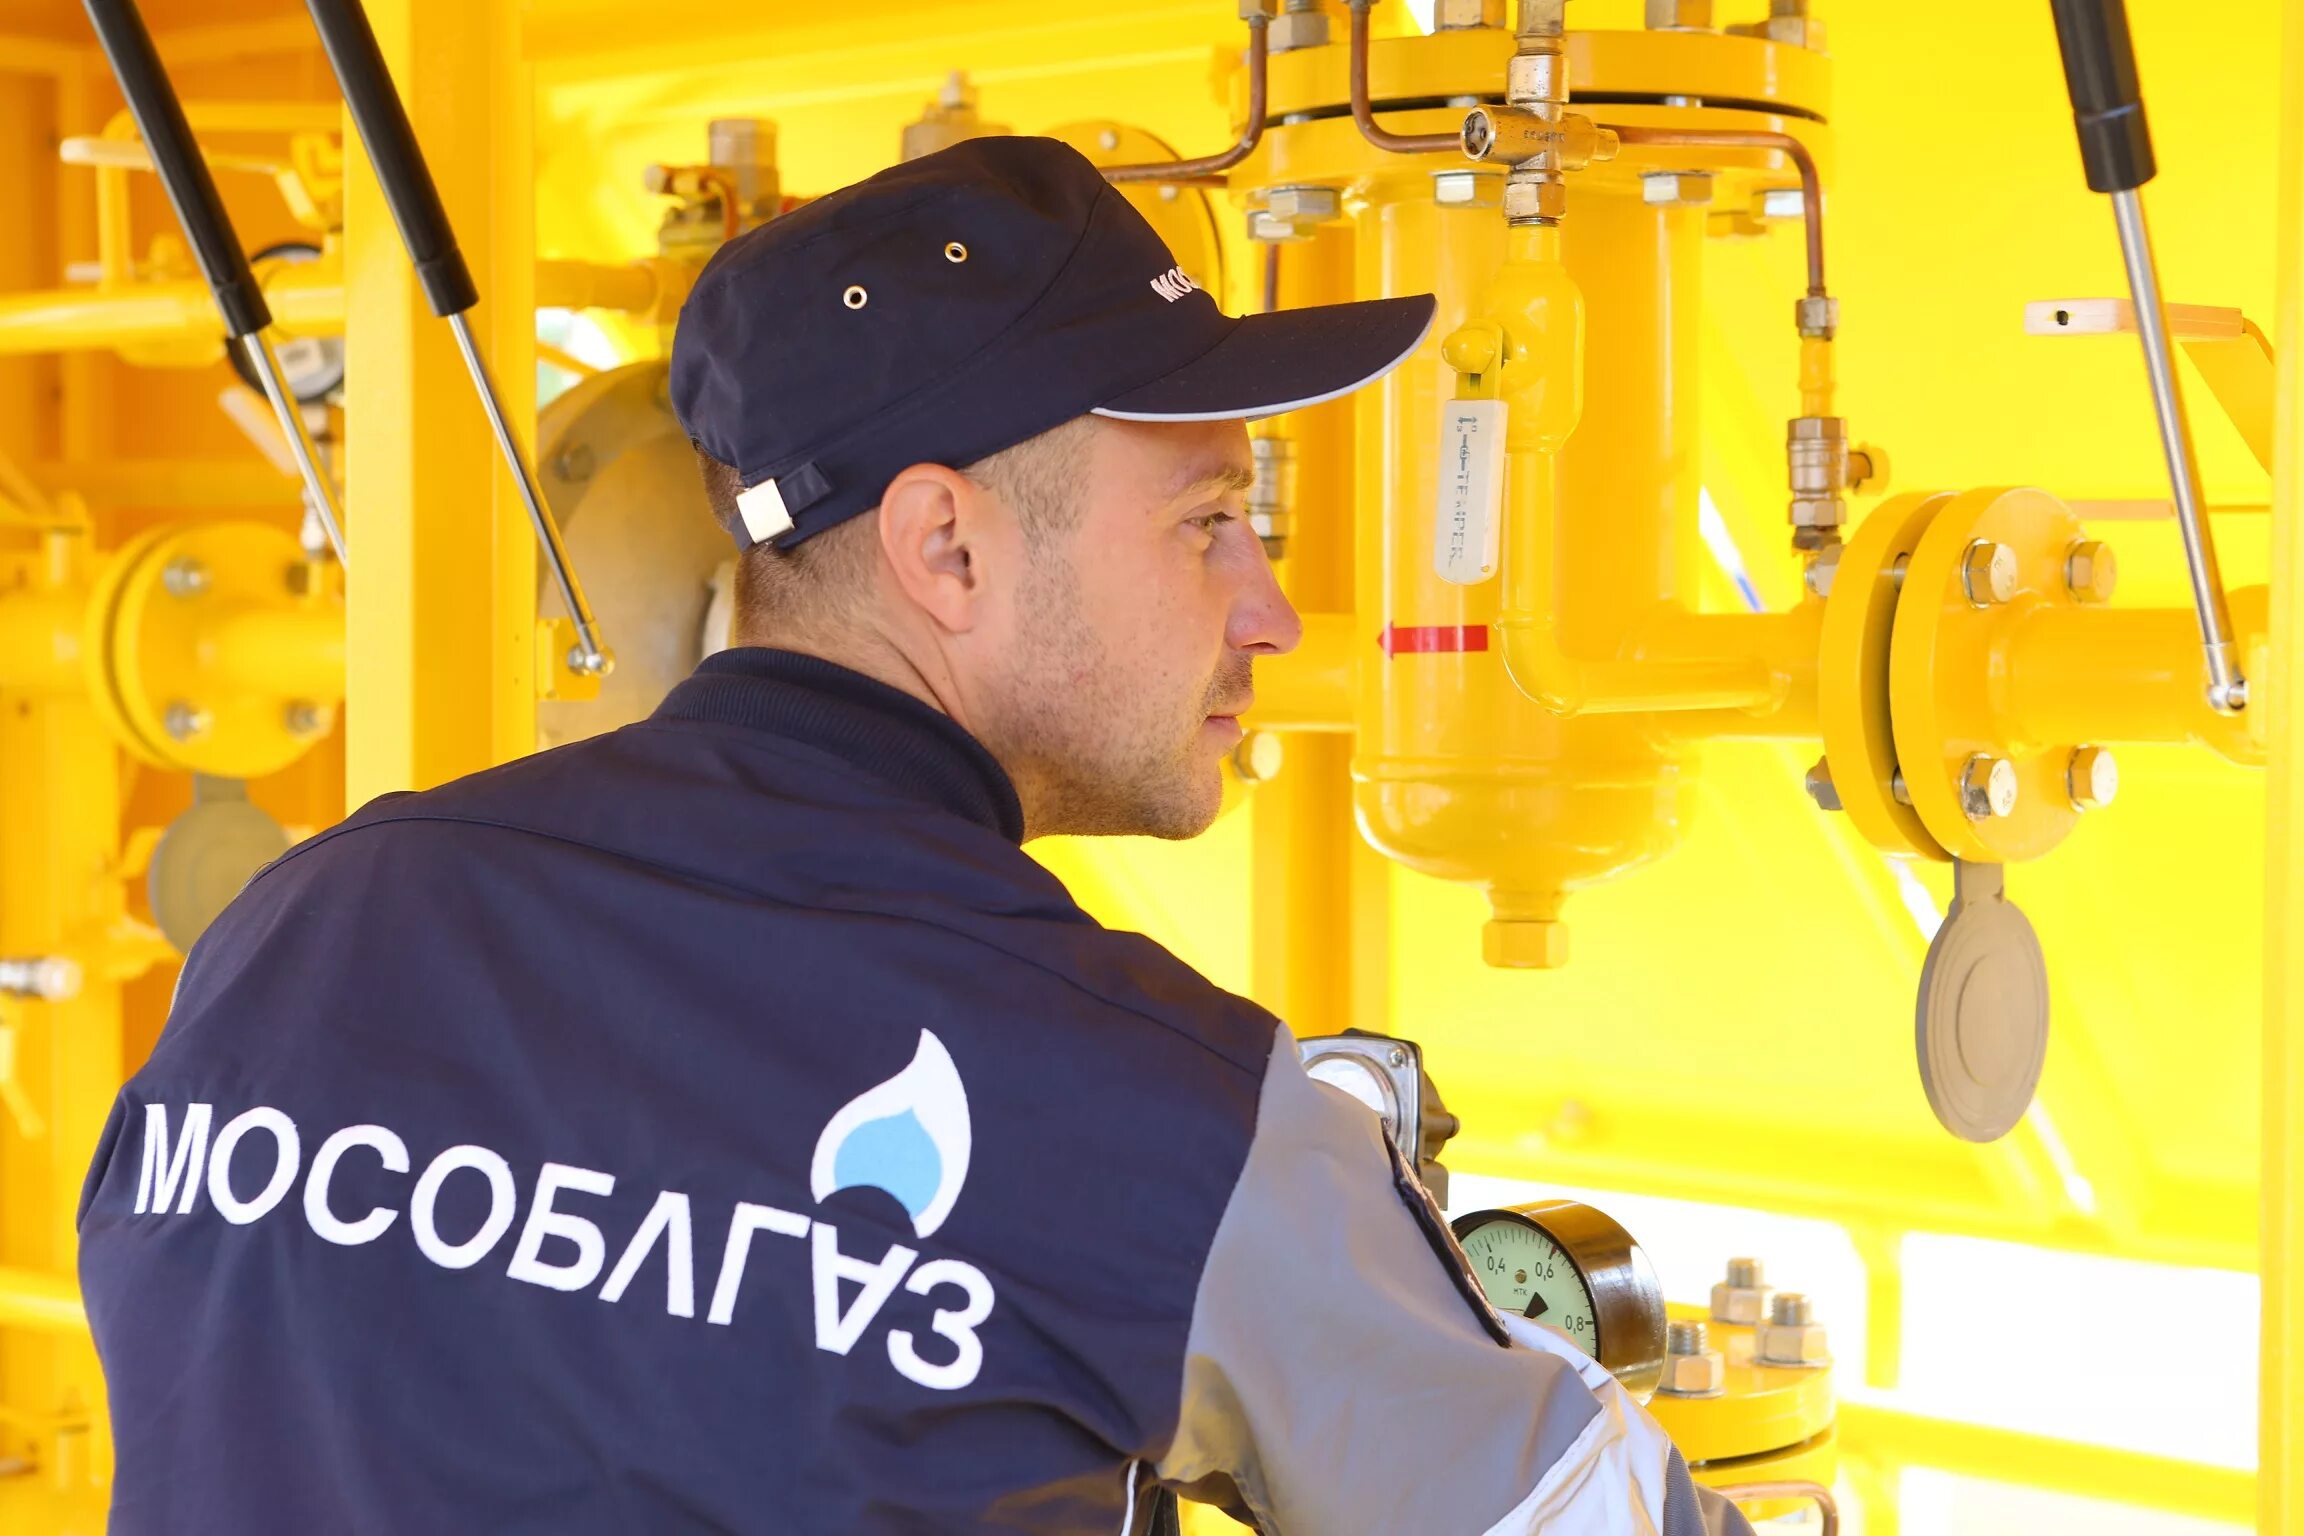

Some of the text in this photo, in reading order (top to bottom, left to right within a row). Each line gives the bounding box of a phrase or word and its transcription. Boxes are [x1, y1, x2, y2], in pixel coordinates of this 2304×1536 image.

[133, 1102, 996, 1390] МОСОБЛГАЗ
[1487, 1255, 1506, 1275] 0,4
[1535, 1261, 1554, 1282] 0,6
[1565, 1314, 1585, 1335] 0,8
